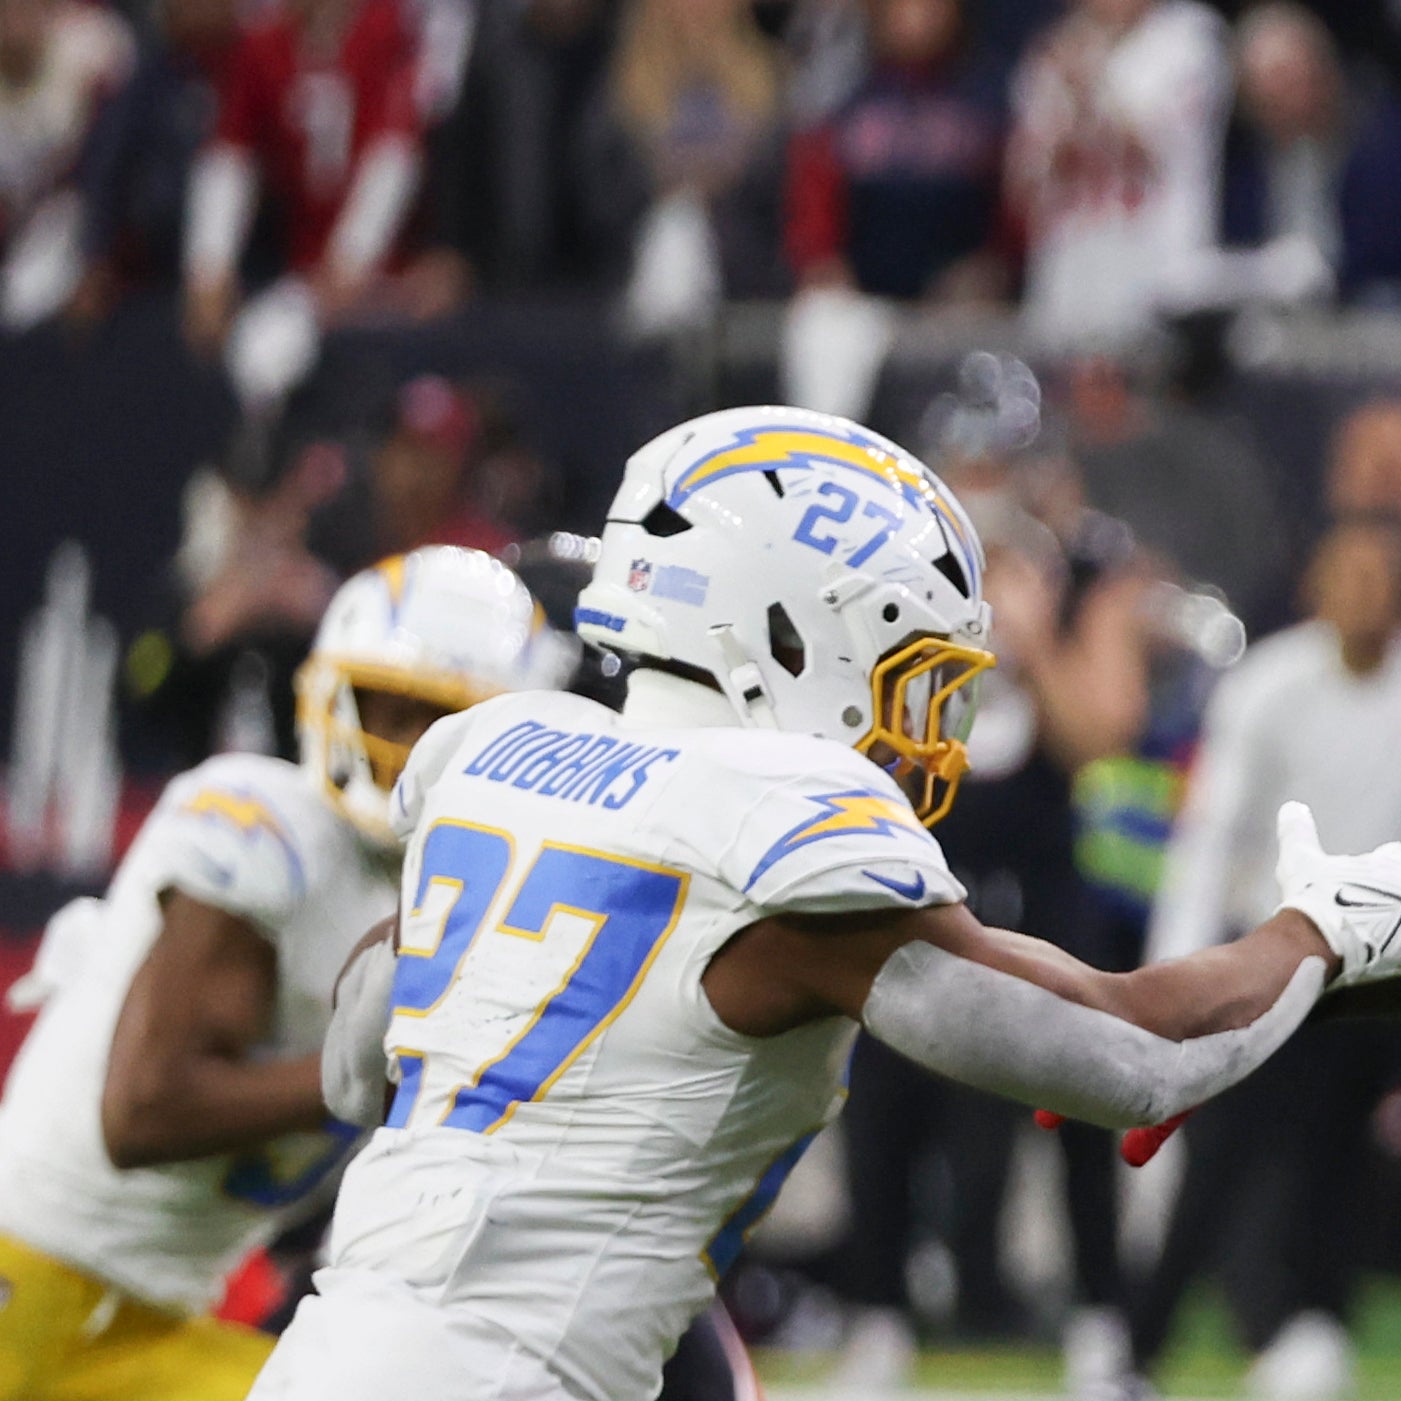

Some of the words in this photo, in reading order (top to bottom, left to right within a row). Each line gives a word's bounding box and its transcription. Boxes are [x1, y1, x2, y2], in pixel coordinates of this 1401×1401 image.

[792, 481, 904, 568] 27
[463, 719, 681, 810] DOBBINS
[384, 817, 691, 1136] 27
